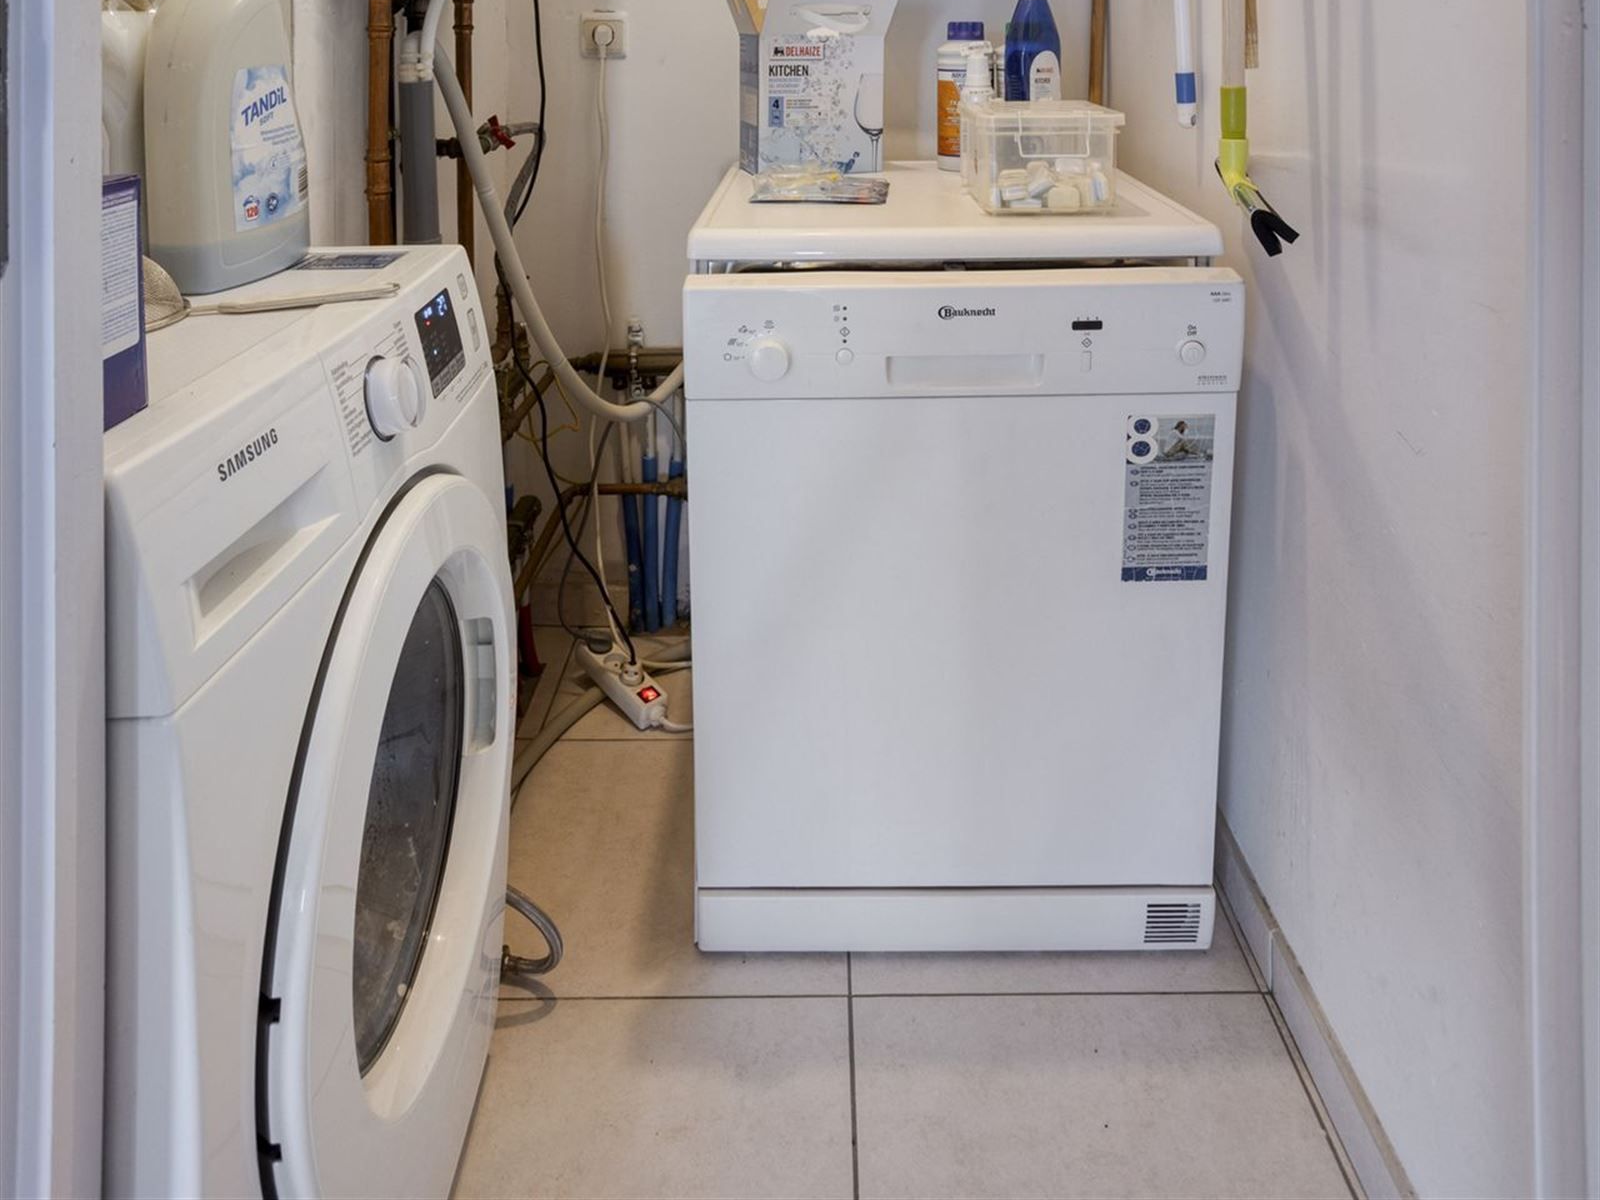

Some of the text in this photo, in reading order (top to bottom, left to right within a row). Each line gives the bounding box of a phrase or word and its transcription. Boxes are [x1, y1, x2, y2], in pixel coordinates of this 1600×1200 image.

[785, 46, 821, 57] DELHAIZE
[768, 64, 809, 77] KITCHEN
[773, 99, 780, 109] 4
[938, 305, 996, 320] Bauknecht
[217, 428, 279, 482] SAMSUNG
